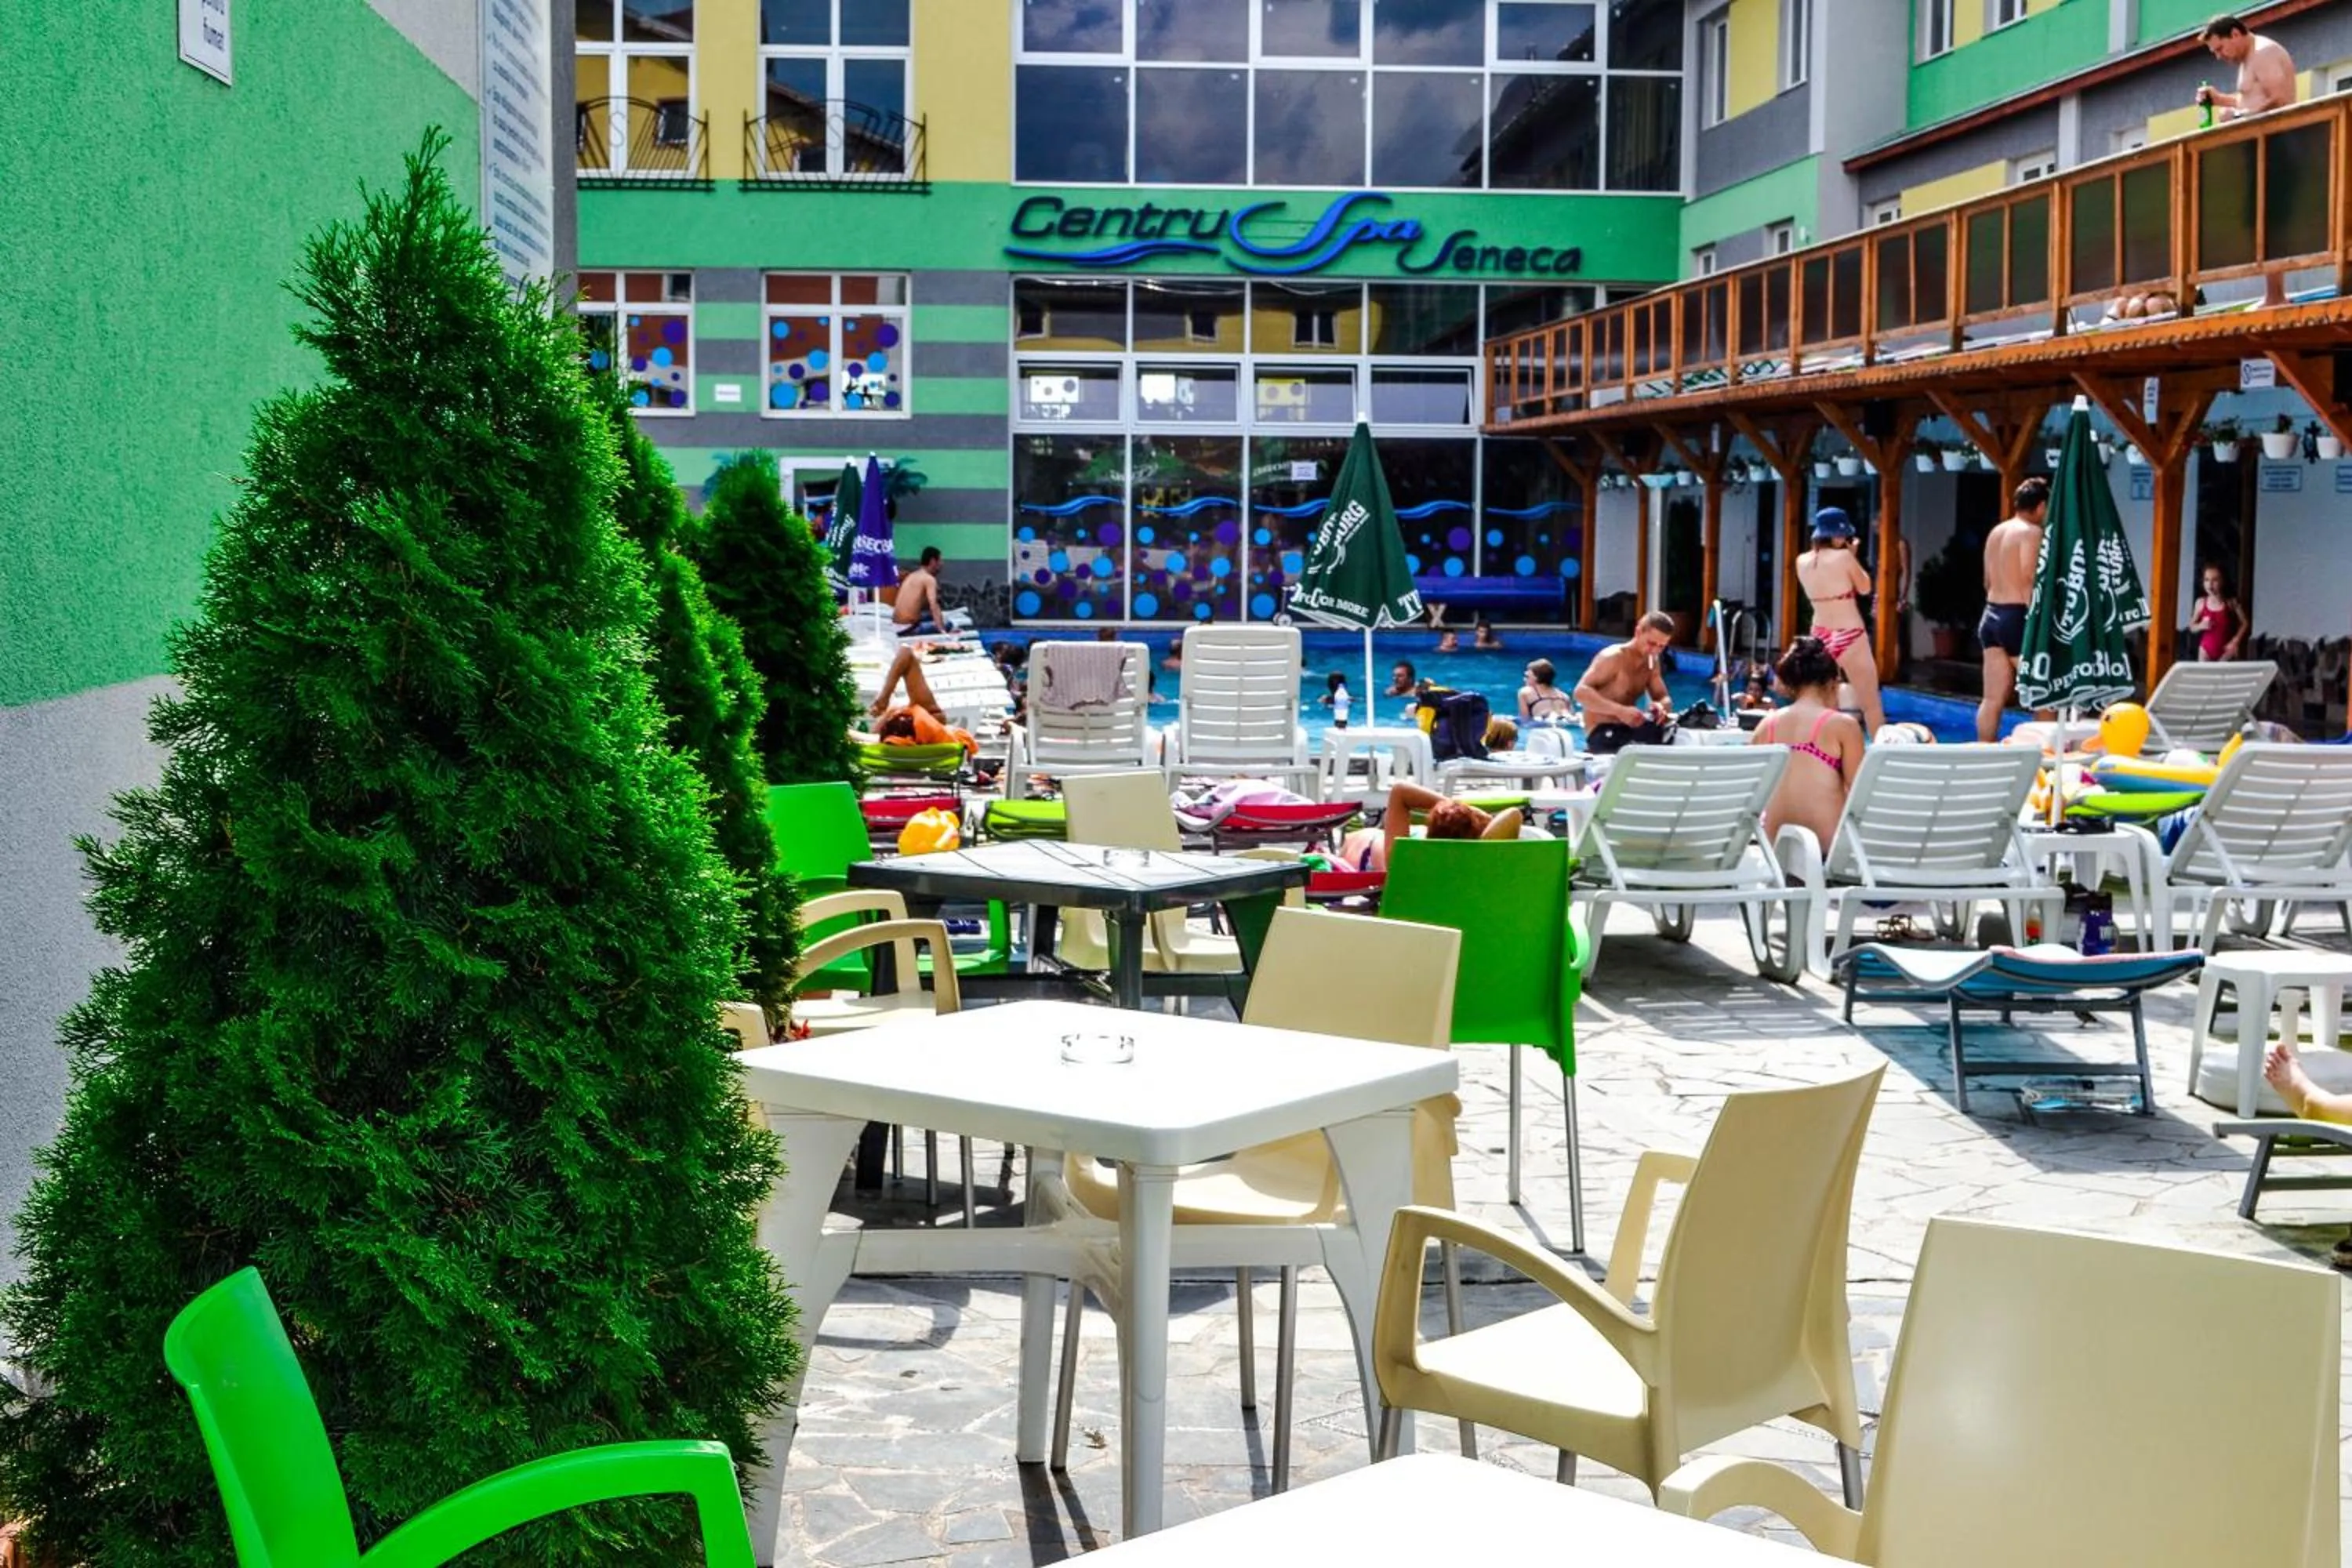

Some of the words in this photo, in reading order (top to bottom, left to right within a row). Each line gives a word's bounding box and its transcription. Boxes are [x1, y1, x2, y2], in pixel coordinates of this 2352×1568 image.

[1010, 195, 1231, 241] Centru
[1225, 191, 1423, 275] Spa
[1396, 229, 1582, 274] Seneca
